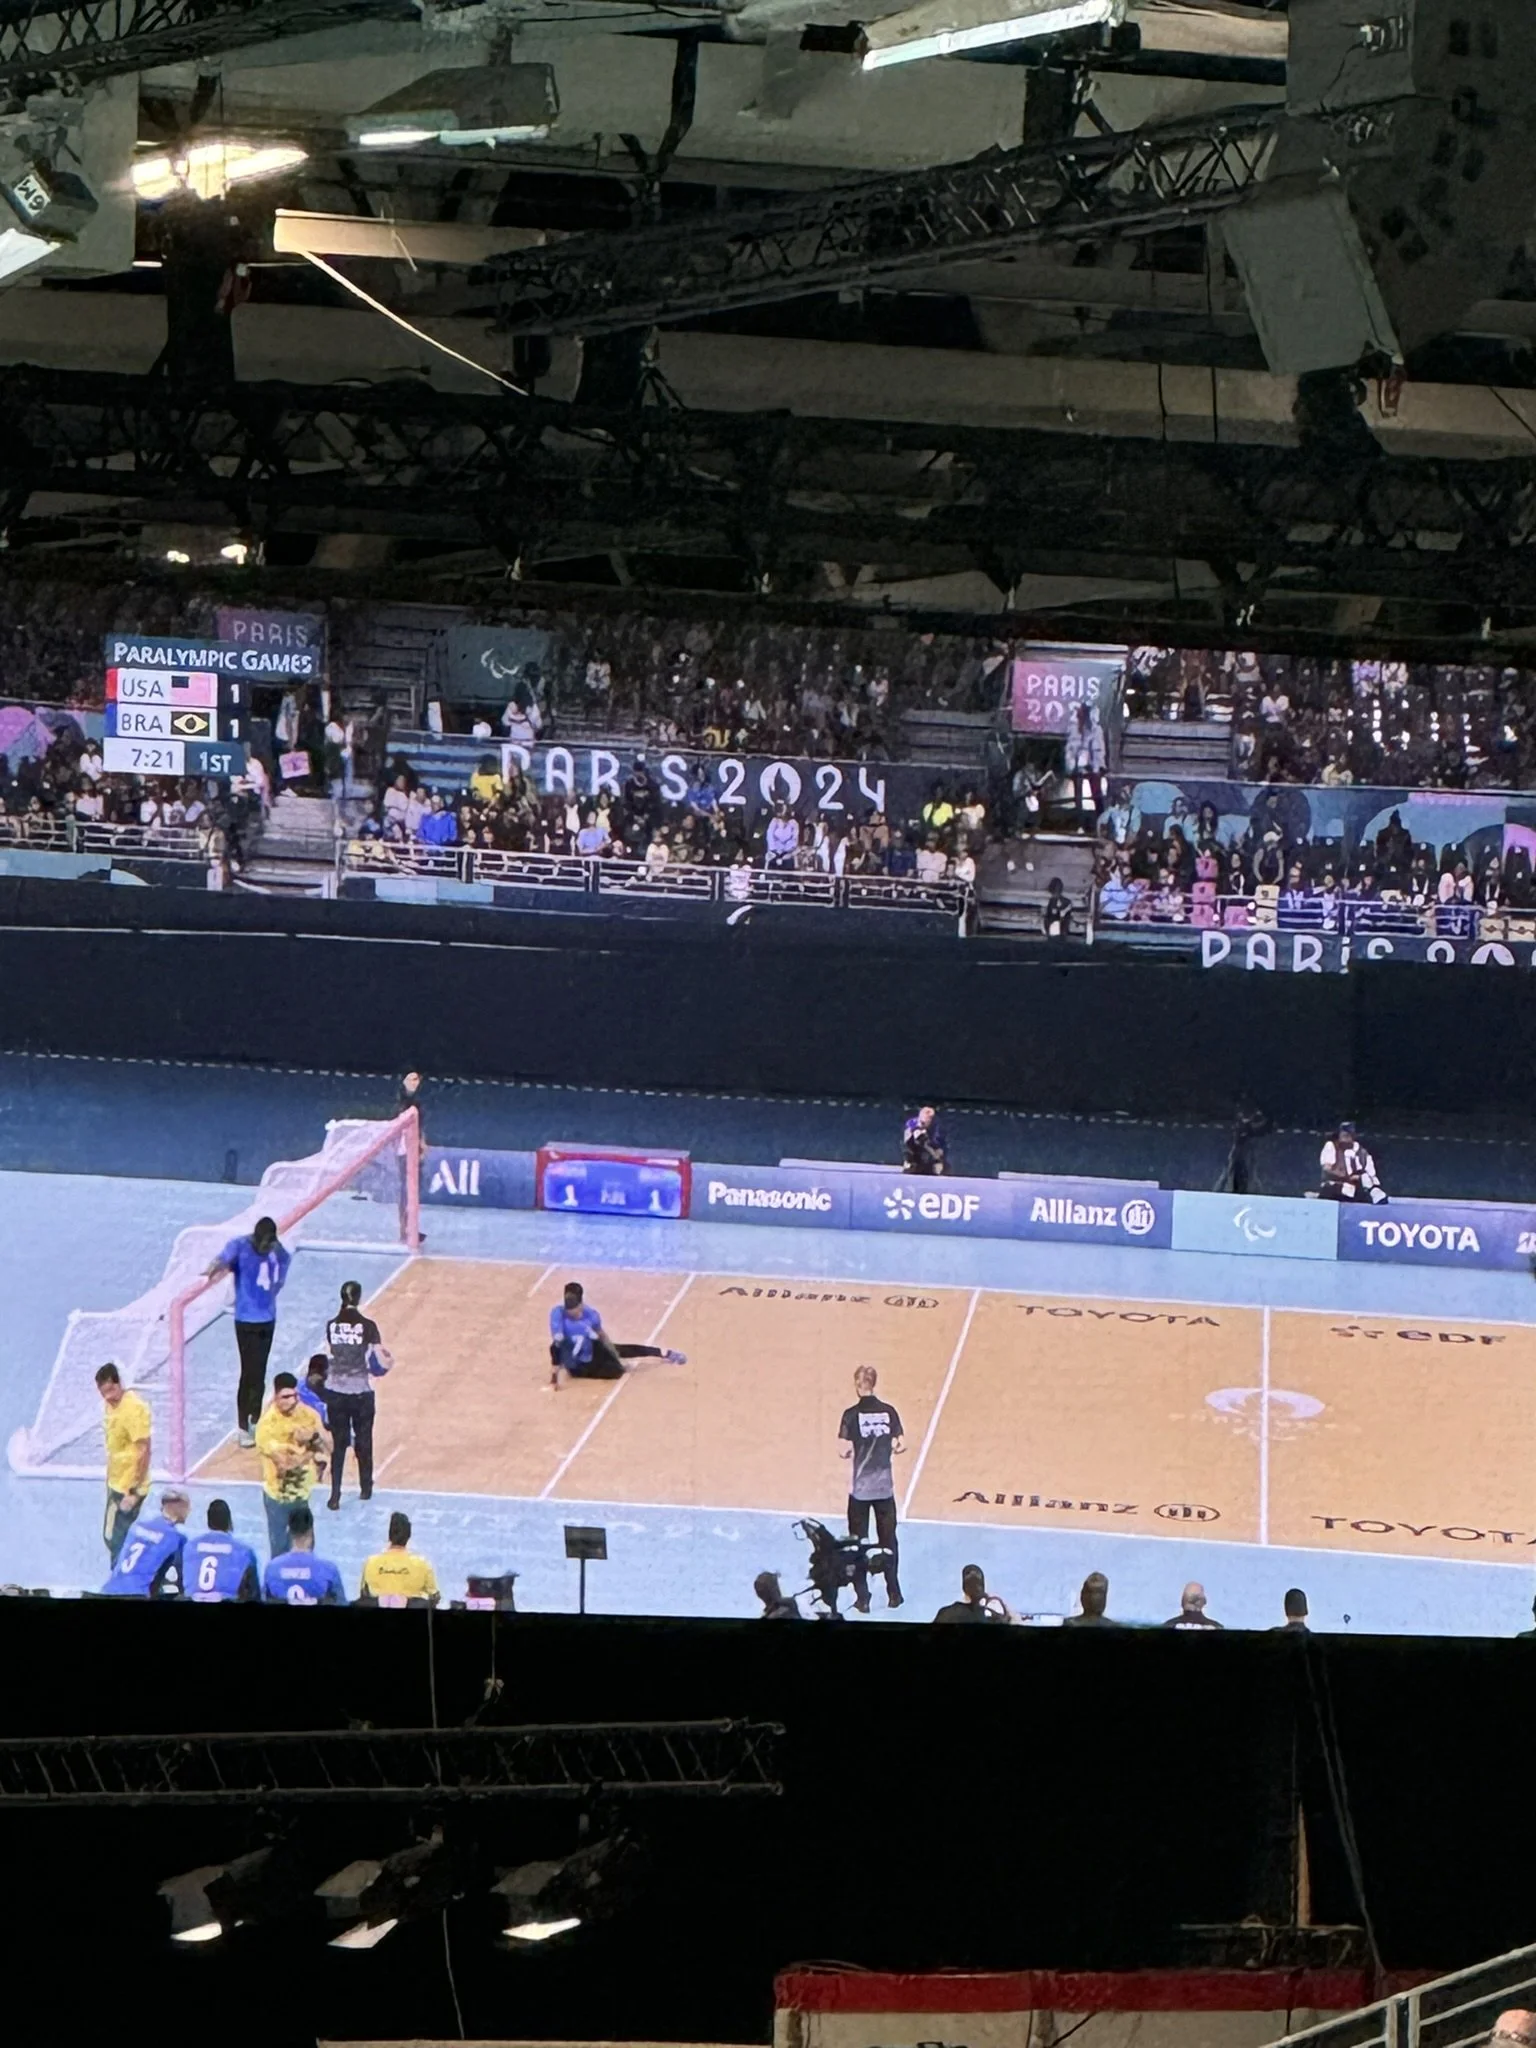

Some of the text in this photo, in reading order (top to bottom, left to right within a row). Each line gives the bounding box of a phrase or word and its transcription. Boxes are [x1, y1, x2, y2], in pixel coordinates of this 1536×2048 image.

[233, 620, 309, 647] PARIS
[114, 642, 312, 674] PARALYMPIC GAMES
[121, 677, 240, 704] USA 1
[1027, 674, 1100, 698] PARIS
[121, 713, 240, 738] BRA 1
[131, 749, 231, 772] 7:21 1ST
[500, 743, 886, 813] PARS 2024
[708, 1181, 832, 1211] Panasonic
[1030, 1197, 1118, 1227] Allianz
[1359, 1220, 1480, 1252] TOYOTA
[1017, 1304, 1220, 1327] TOYOTA
[953, 1491, 1138, 1515] Allianz
[1311, 1516, 1536, 1545] TOYOT
[198, 1556, 218, 1591] 6
